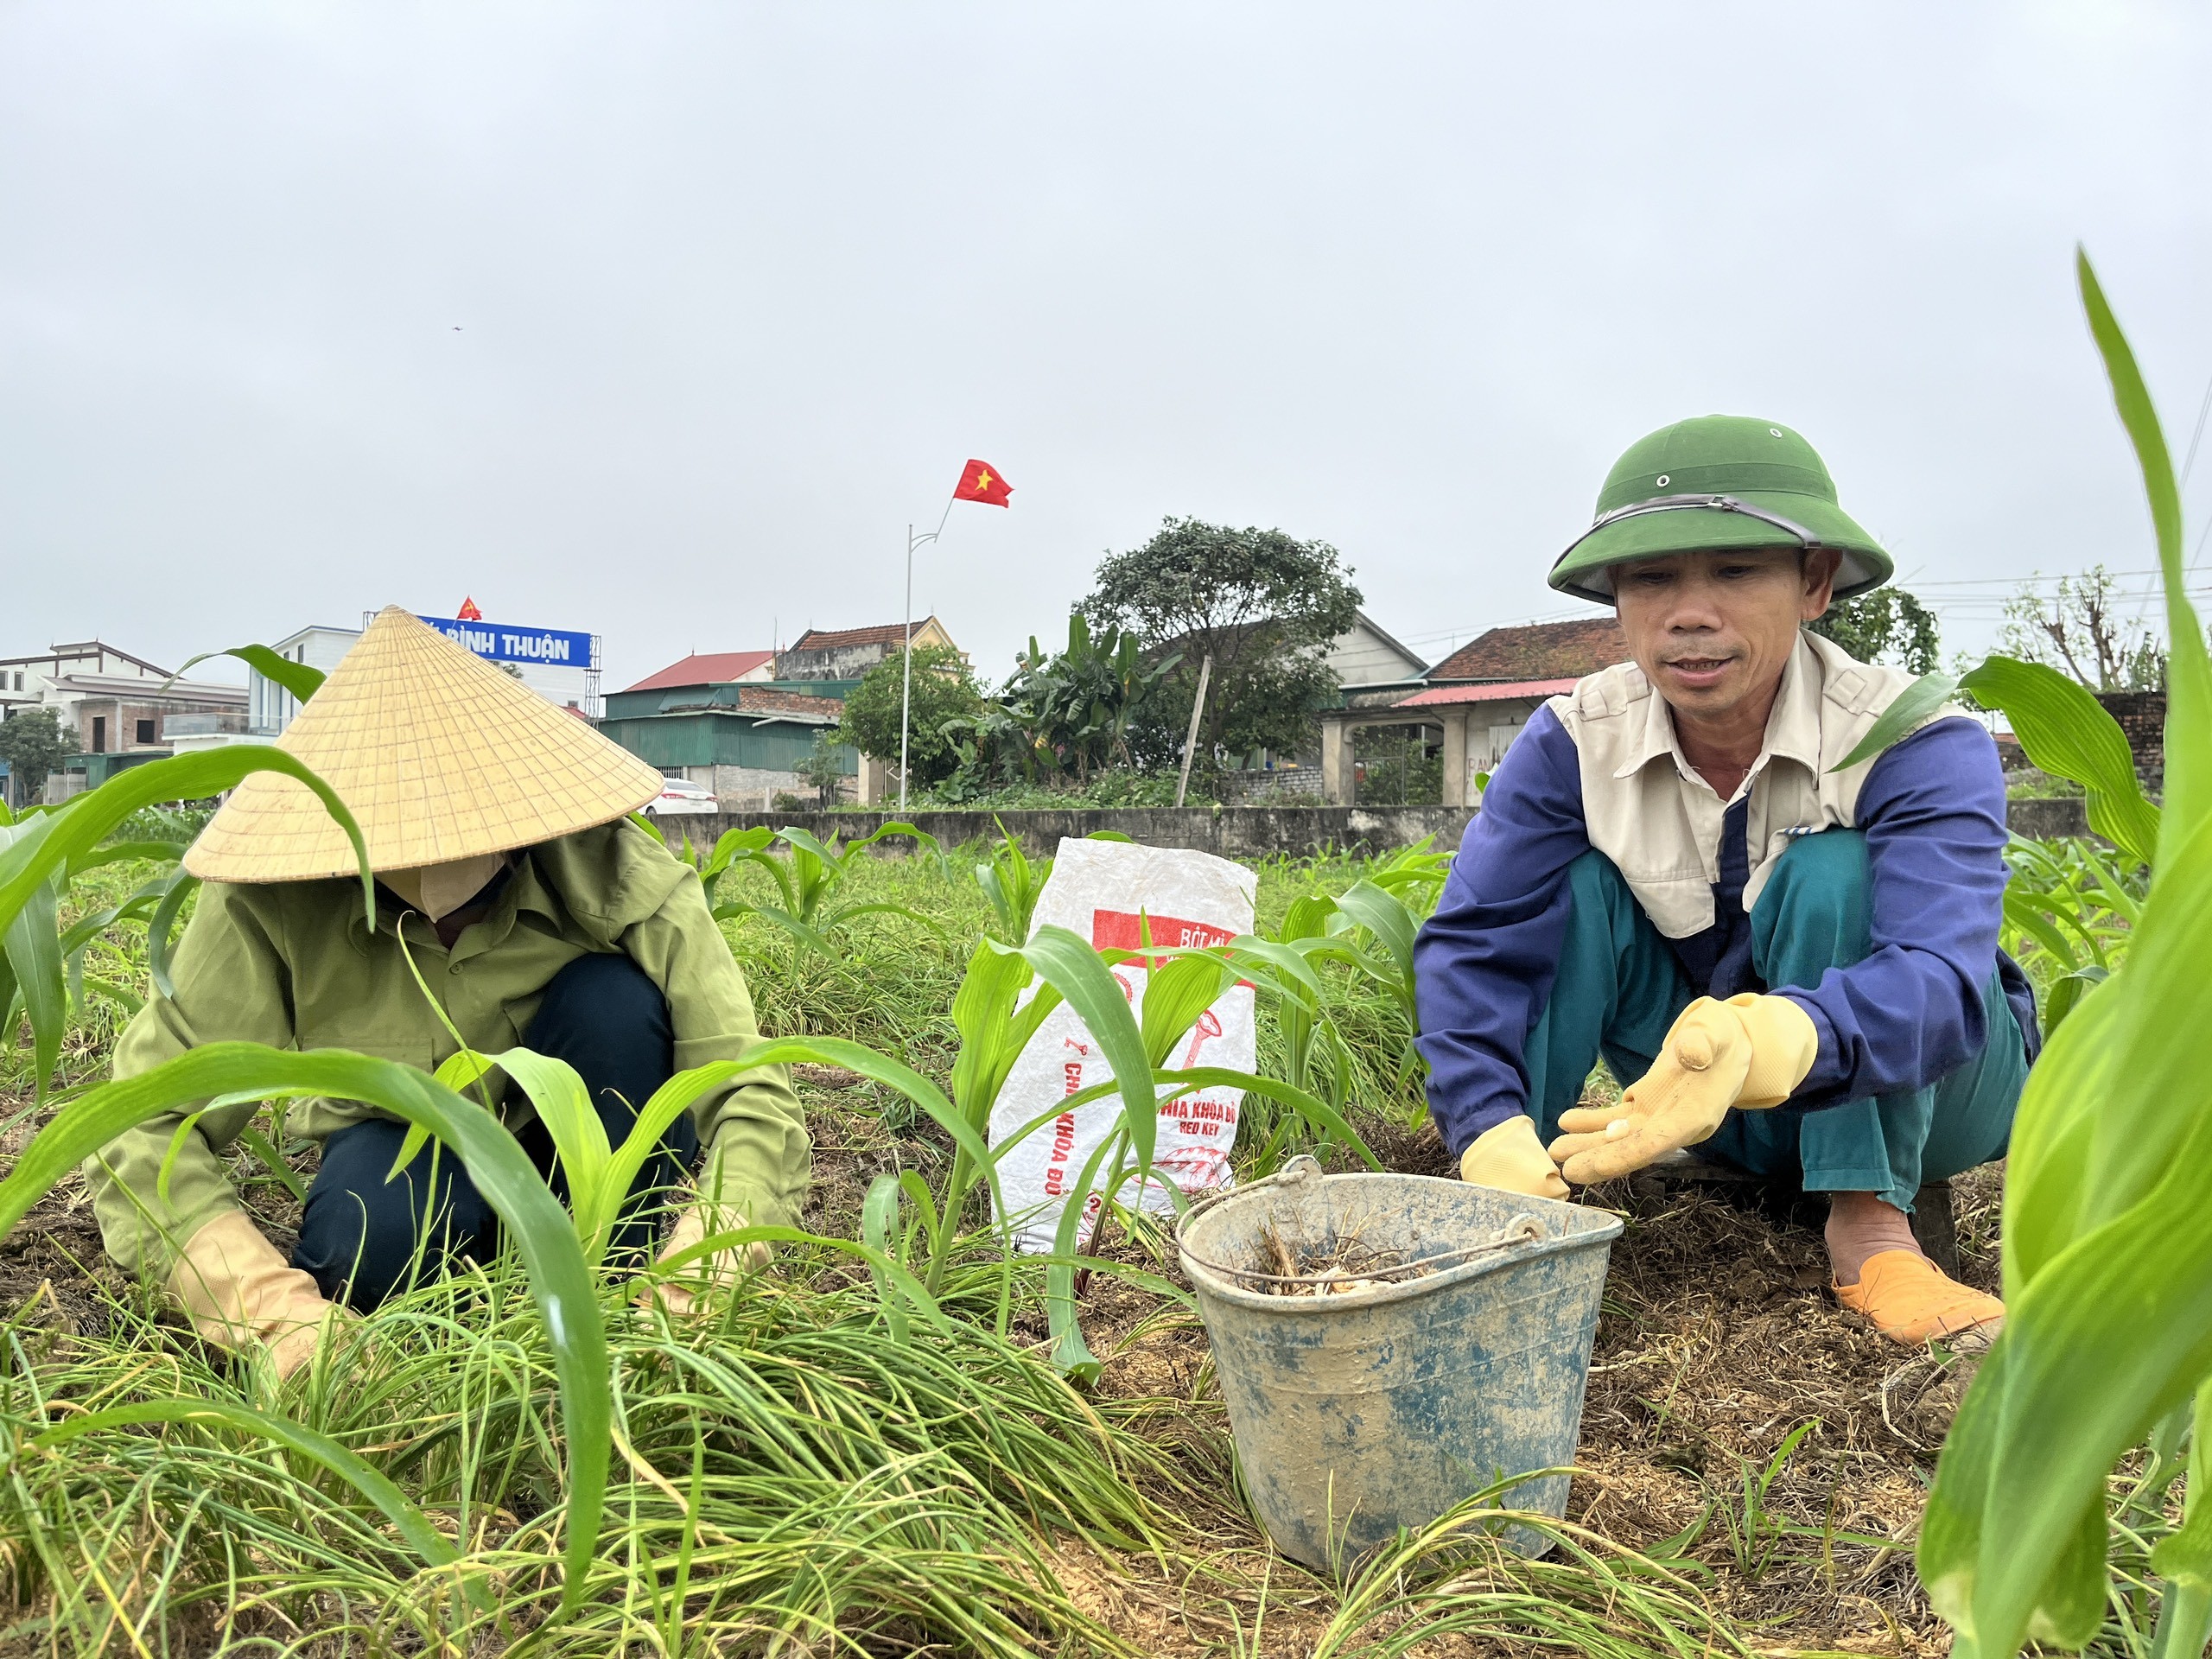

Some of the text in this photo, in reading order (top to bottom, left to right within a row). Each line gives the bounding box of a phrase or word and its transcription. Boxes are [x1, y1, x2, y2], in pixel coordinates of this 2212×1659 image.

[502, 633, 569, 664] THUẬN
[1192, 1099, 1224, 1121] KHÓA
[1179, 1121, 1220, 1136] RED KEY
